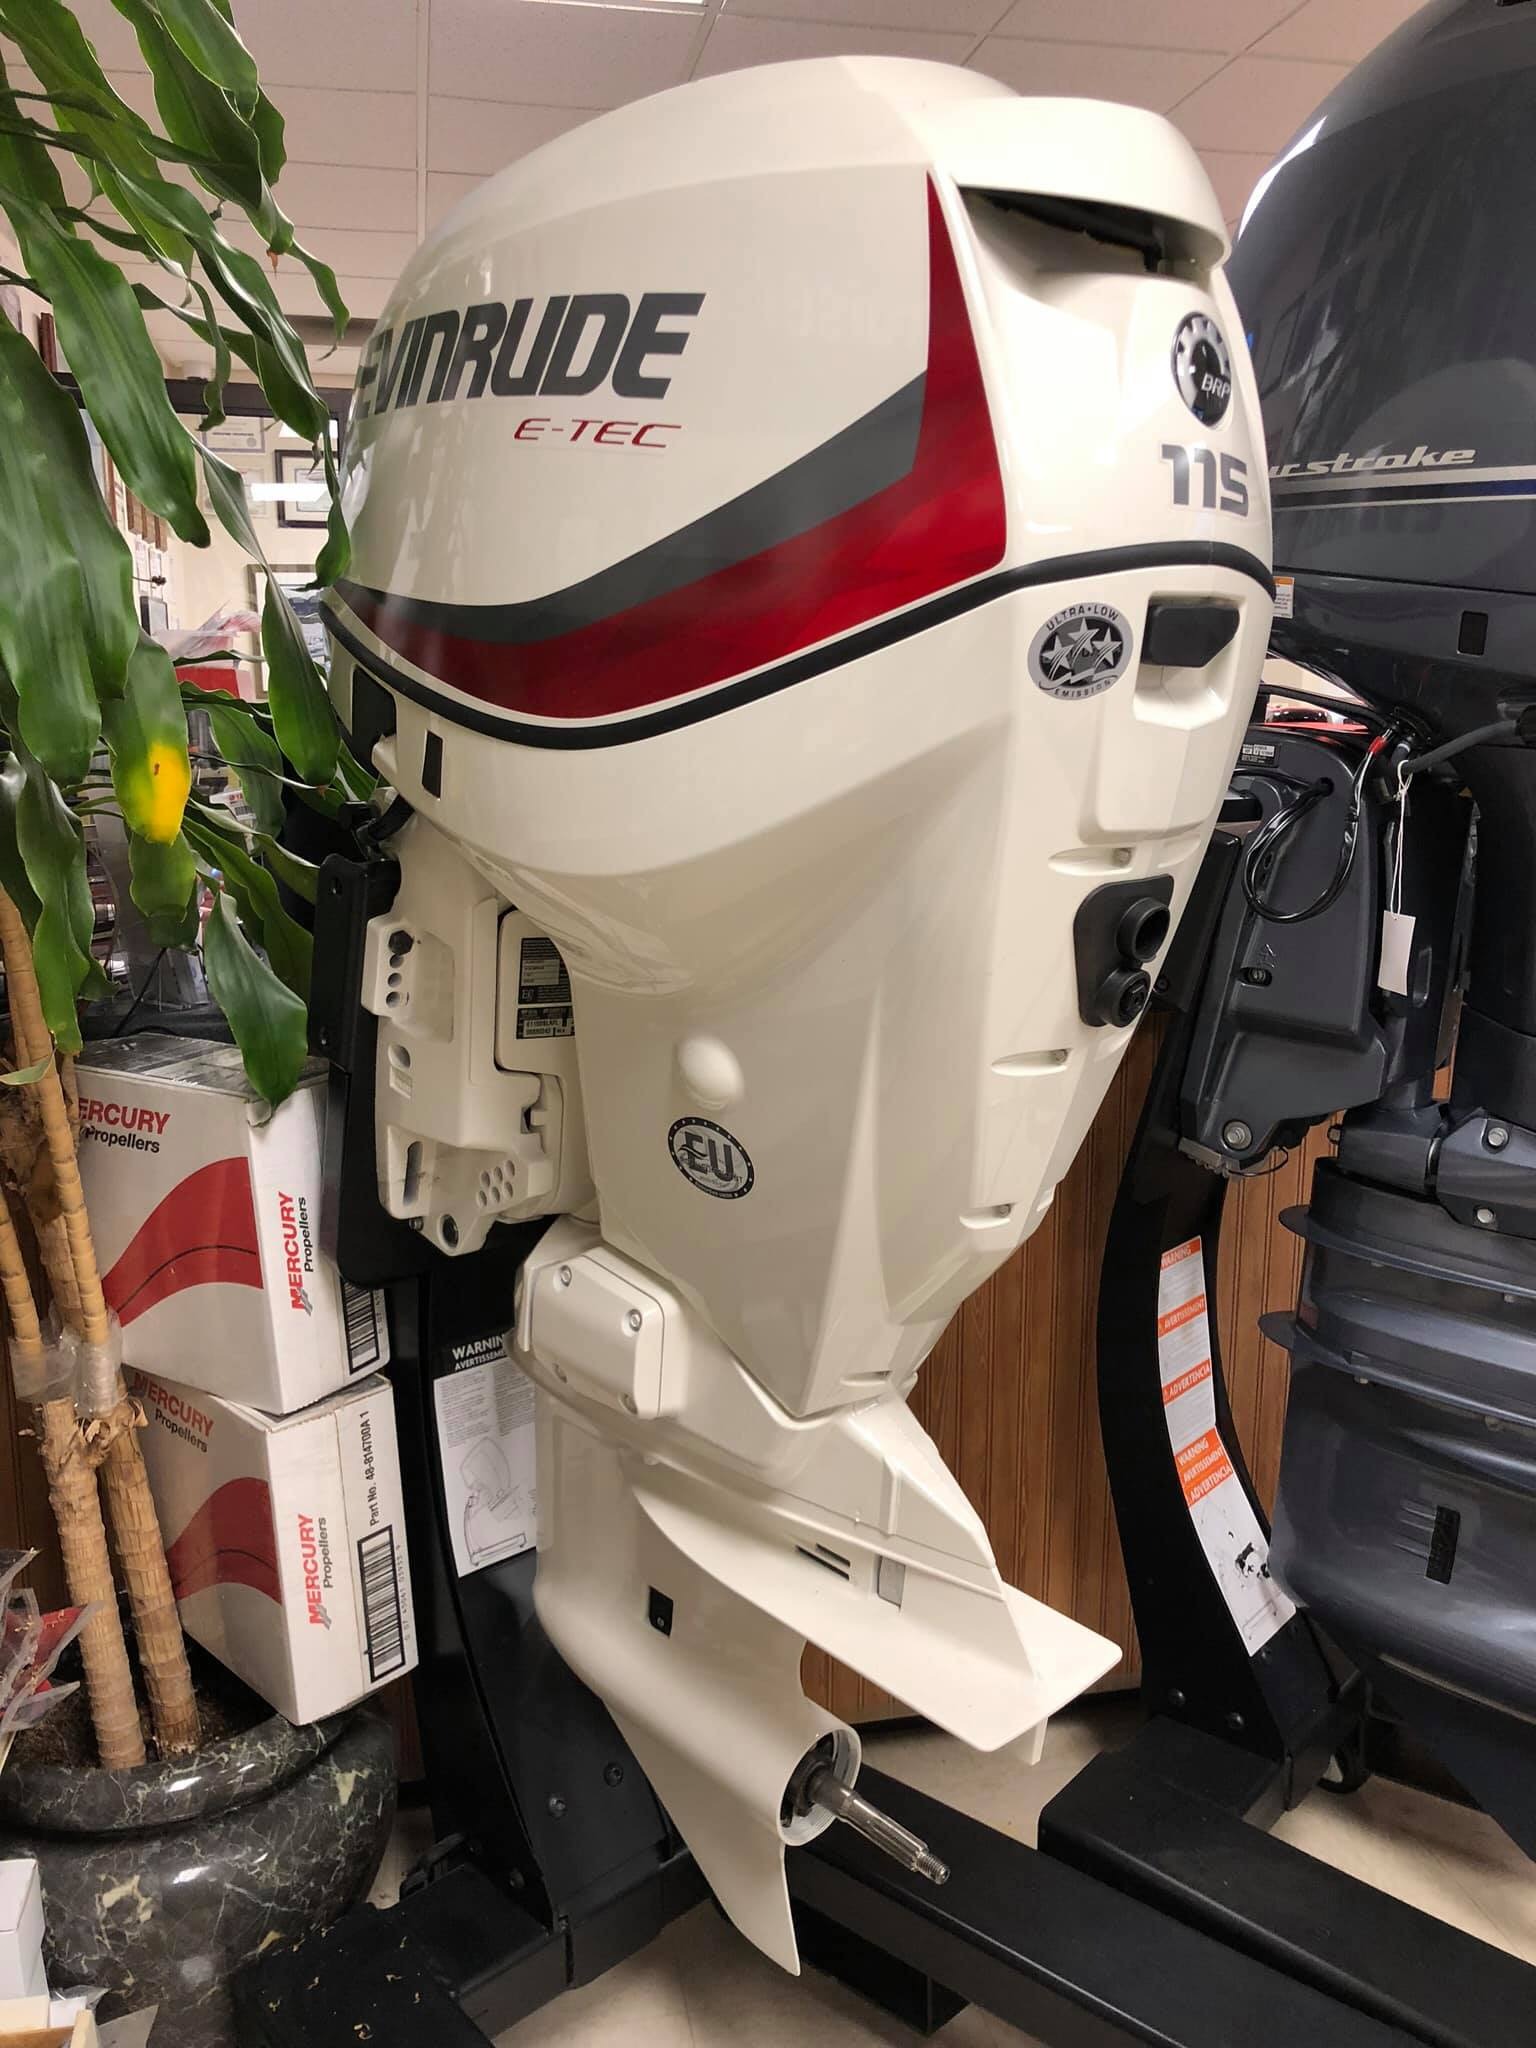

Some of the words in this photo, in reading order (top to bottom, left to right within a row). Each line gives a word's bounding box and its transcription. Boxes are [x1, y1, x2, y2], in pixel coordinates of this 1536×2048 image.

[354, 292, 706, 419] EVINRUDE
[1201, 373, 1231, 399] BRP
[514, 417, 682, 448] E-TEC
[1161, 443, 1249, 518] 115
[78, 1097, 171, 1135] ERCURY
[85, 1125, 161, 1154] Propellers
[278, 1190, 305, 1310] MERCURY
[298, 1196, 314, 1273] Propellers
[452, 1333, 505, 1361] WARNIN
[134, 1372, 214, 1437] MERCURY
[155, 1408, 208, 1453] Propellers
[369, 1502, 380, 1527] Part
[297, 1513, 323, 1624] MERCURY
[318, 1517, 334, 1588] Propellers
